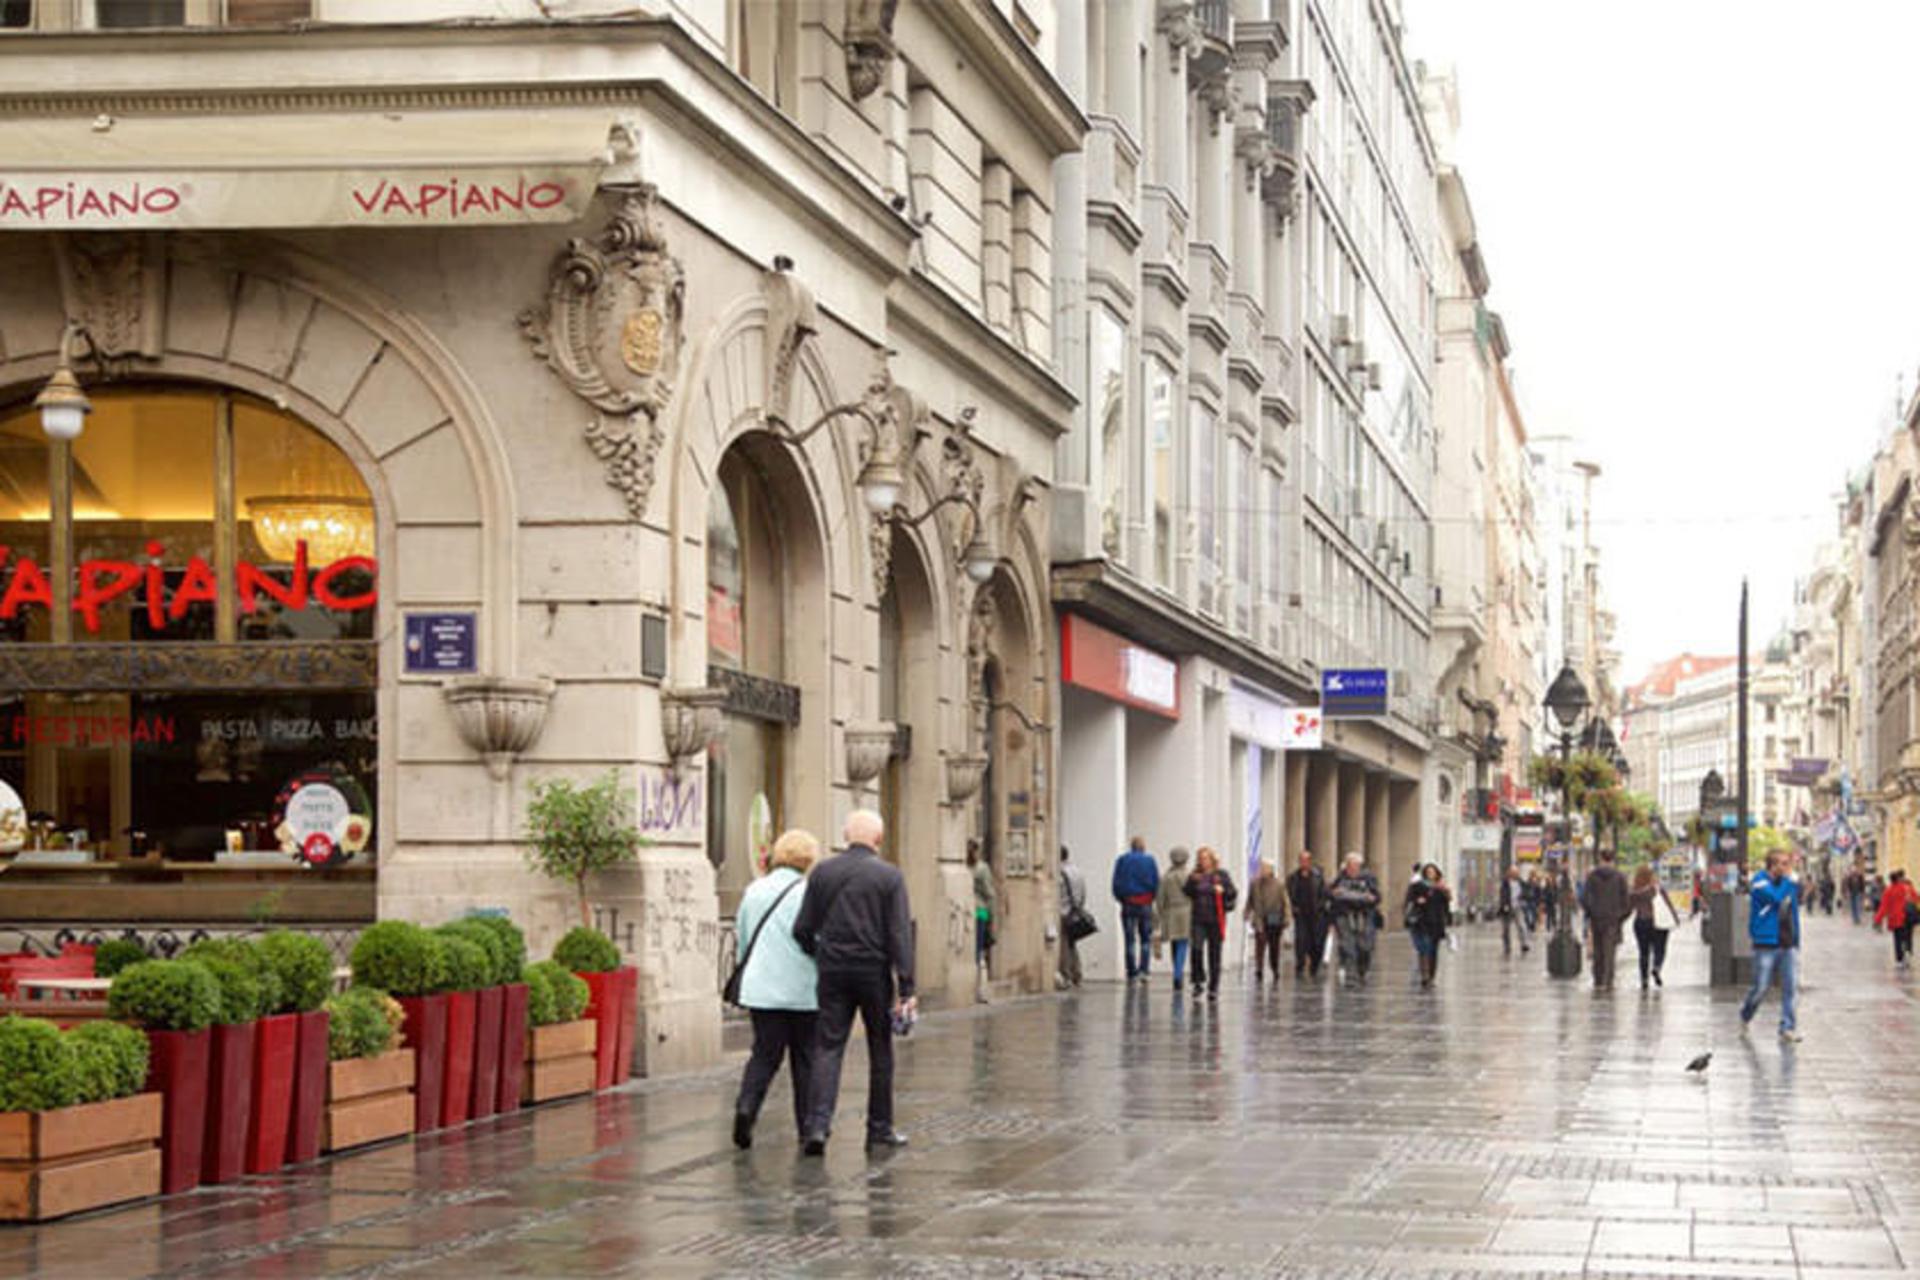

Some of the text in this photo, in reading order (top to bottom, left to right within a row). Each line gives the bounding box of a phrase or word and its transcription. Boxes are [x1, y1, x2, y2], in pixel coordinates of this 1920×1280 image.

[0, 182, 180, 219] APiANO
[201, 719, 257, 740] PASTA
[271, 719, 324, 740] PIZZA
